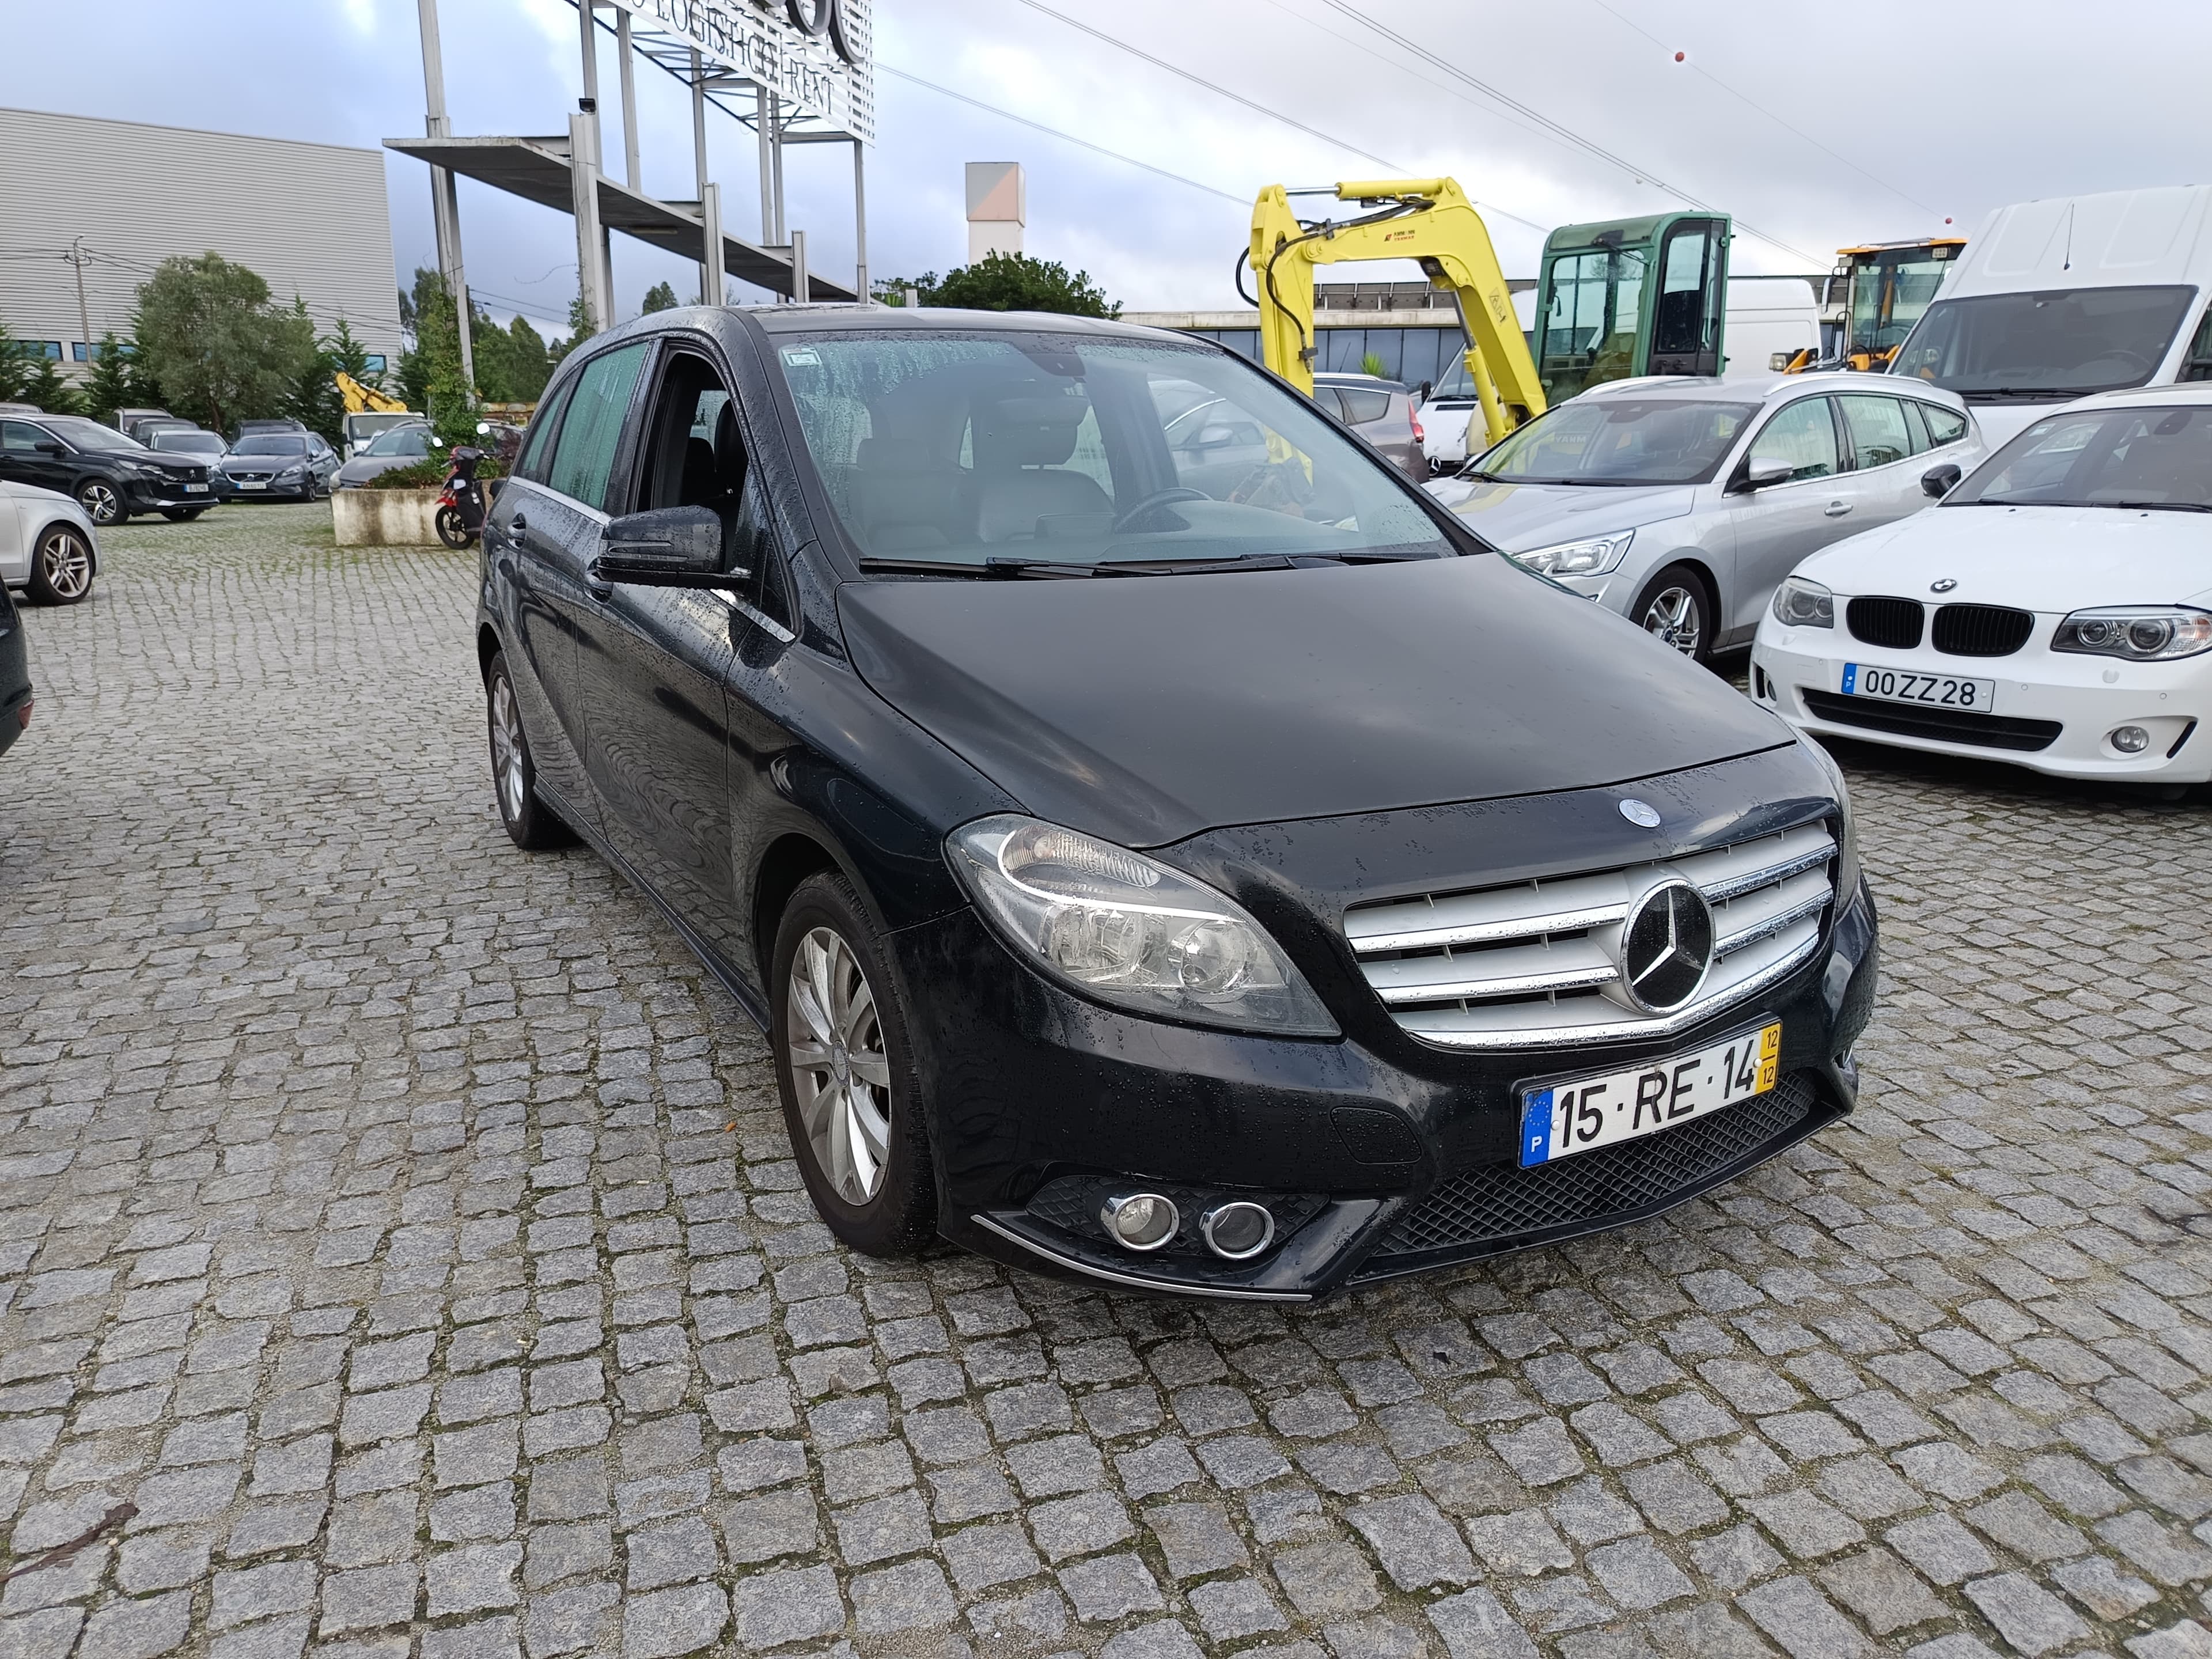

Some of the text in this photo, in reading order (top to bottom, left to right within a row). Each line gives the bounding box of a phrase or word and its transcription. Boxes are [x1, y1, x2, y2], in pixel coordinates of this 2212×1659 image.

[790, 58, 834, 115] RENT
[1766, 1029, 1778, 1050] 12
[1763, 1065, 1775, 1085] 12
[1531, 1135, 1543, 1153] P
